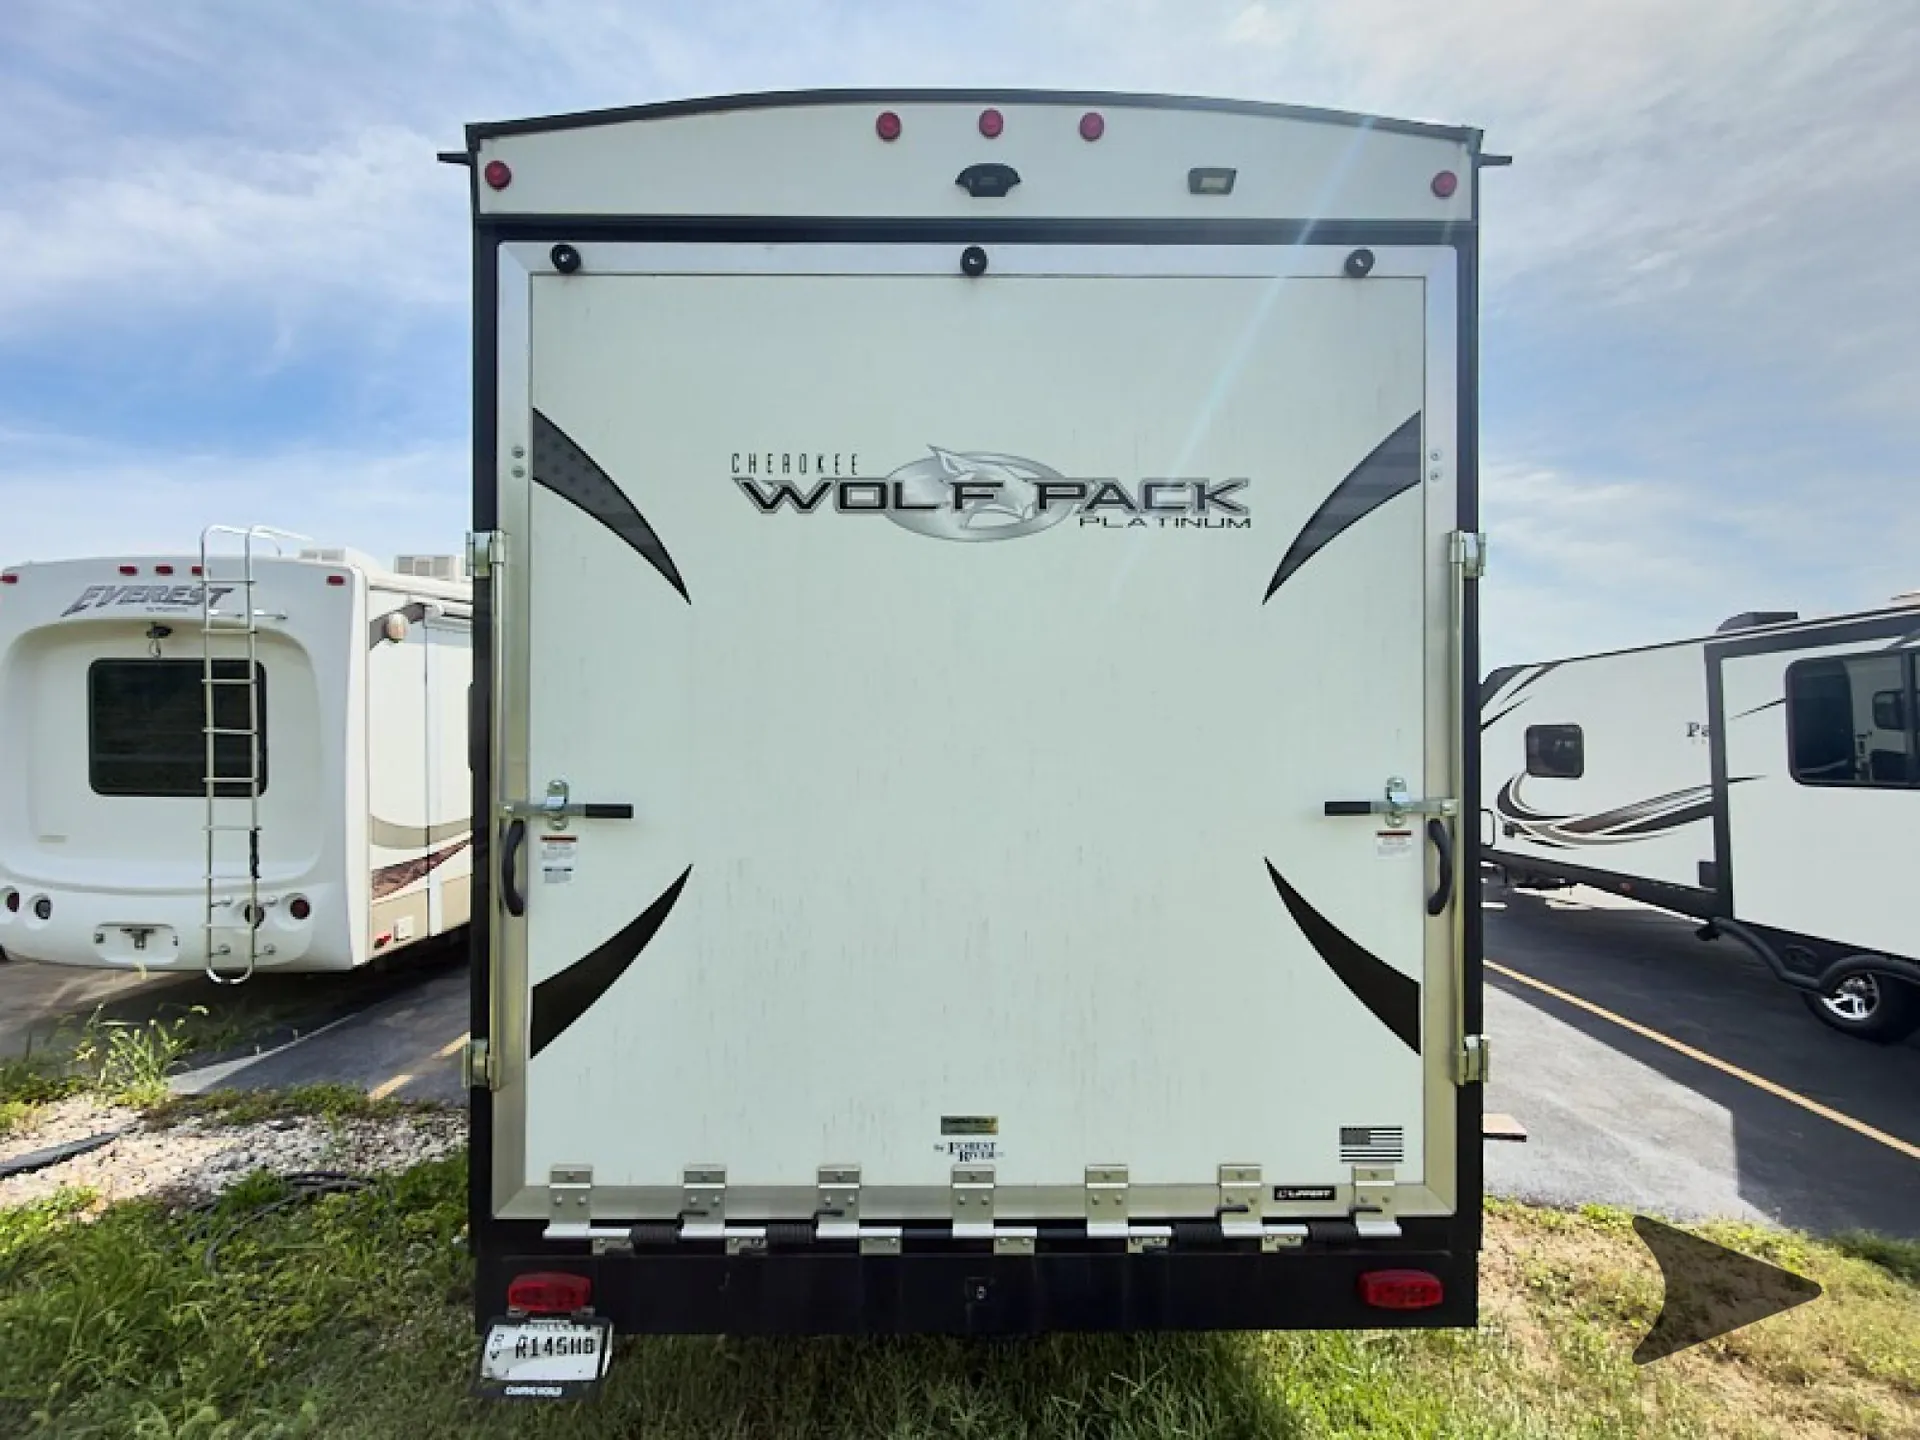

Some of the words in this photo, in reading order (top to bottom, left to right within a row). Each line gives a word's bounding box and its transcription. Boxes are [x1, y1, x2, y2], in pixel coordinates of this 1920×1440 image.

[731, 453, 858, 475] CHEROKEE
[732, 477, 1003, 514] WOLF
[1026, 477, 1251, 514] PACK
[1078, 516, 1252, 529] PLATINUM
[61, 584, 235, 618] EVEREST
